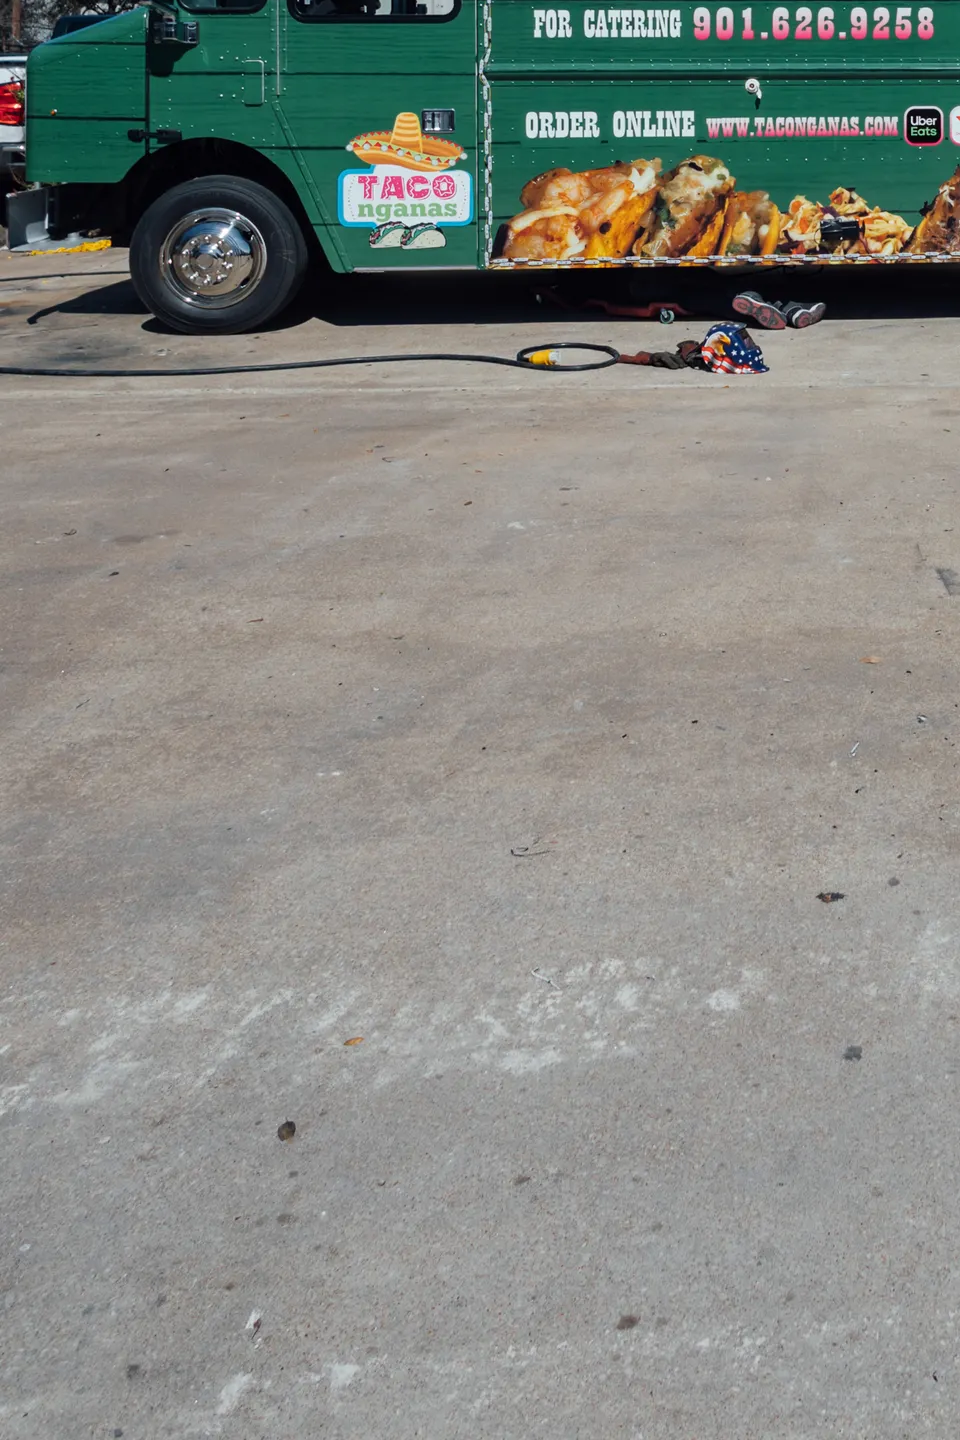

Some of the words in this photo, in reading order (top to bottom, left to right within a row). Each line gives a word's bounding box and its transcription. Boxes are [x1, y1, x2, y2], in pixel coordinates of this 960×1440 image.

[533, 9, 573, 39] FOR
[583, 9, 682, 39] CATERING
[693, 7, 936, 41] 901.626.9258
[525, 111, 601, 139] ORDER
[613, 110, 696, 138] ONLINE
[706, 116, 899, 138] WWW.TACONGANAS.COM
[910, 115, 938, 126] Uber
[910, 126, 937, 137] Eats
[357, 174, 457, 200] TACO
[357, 202, 458, 222] nganas
